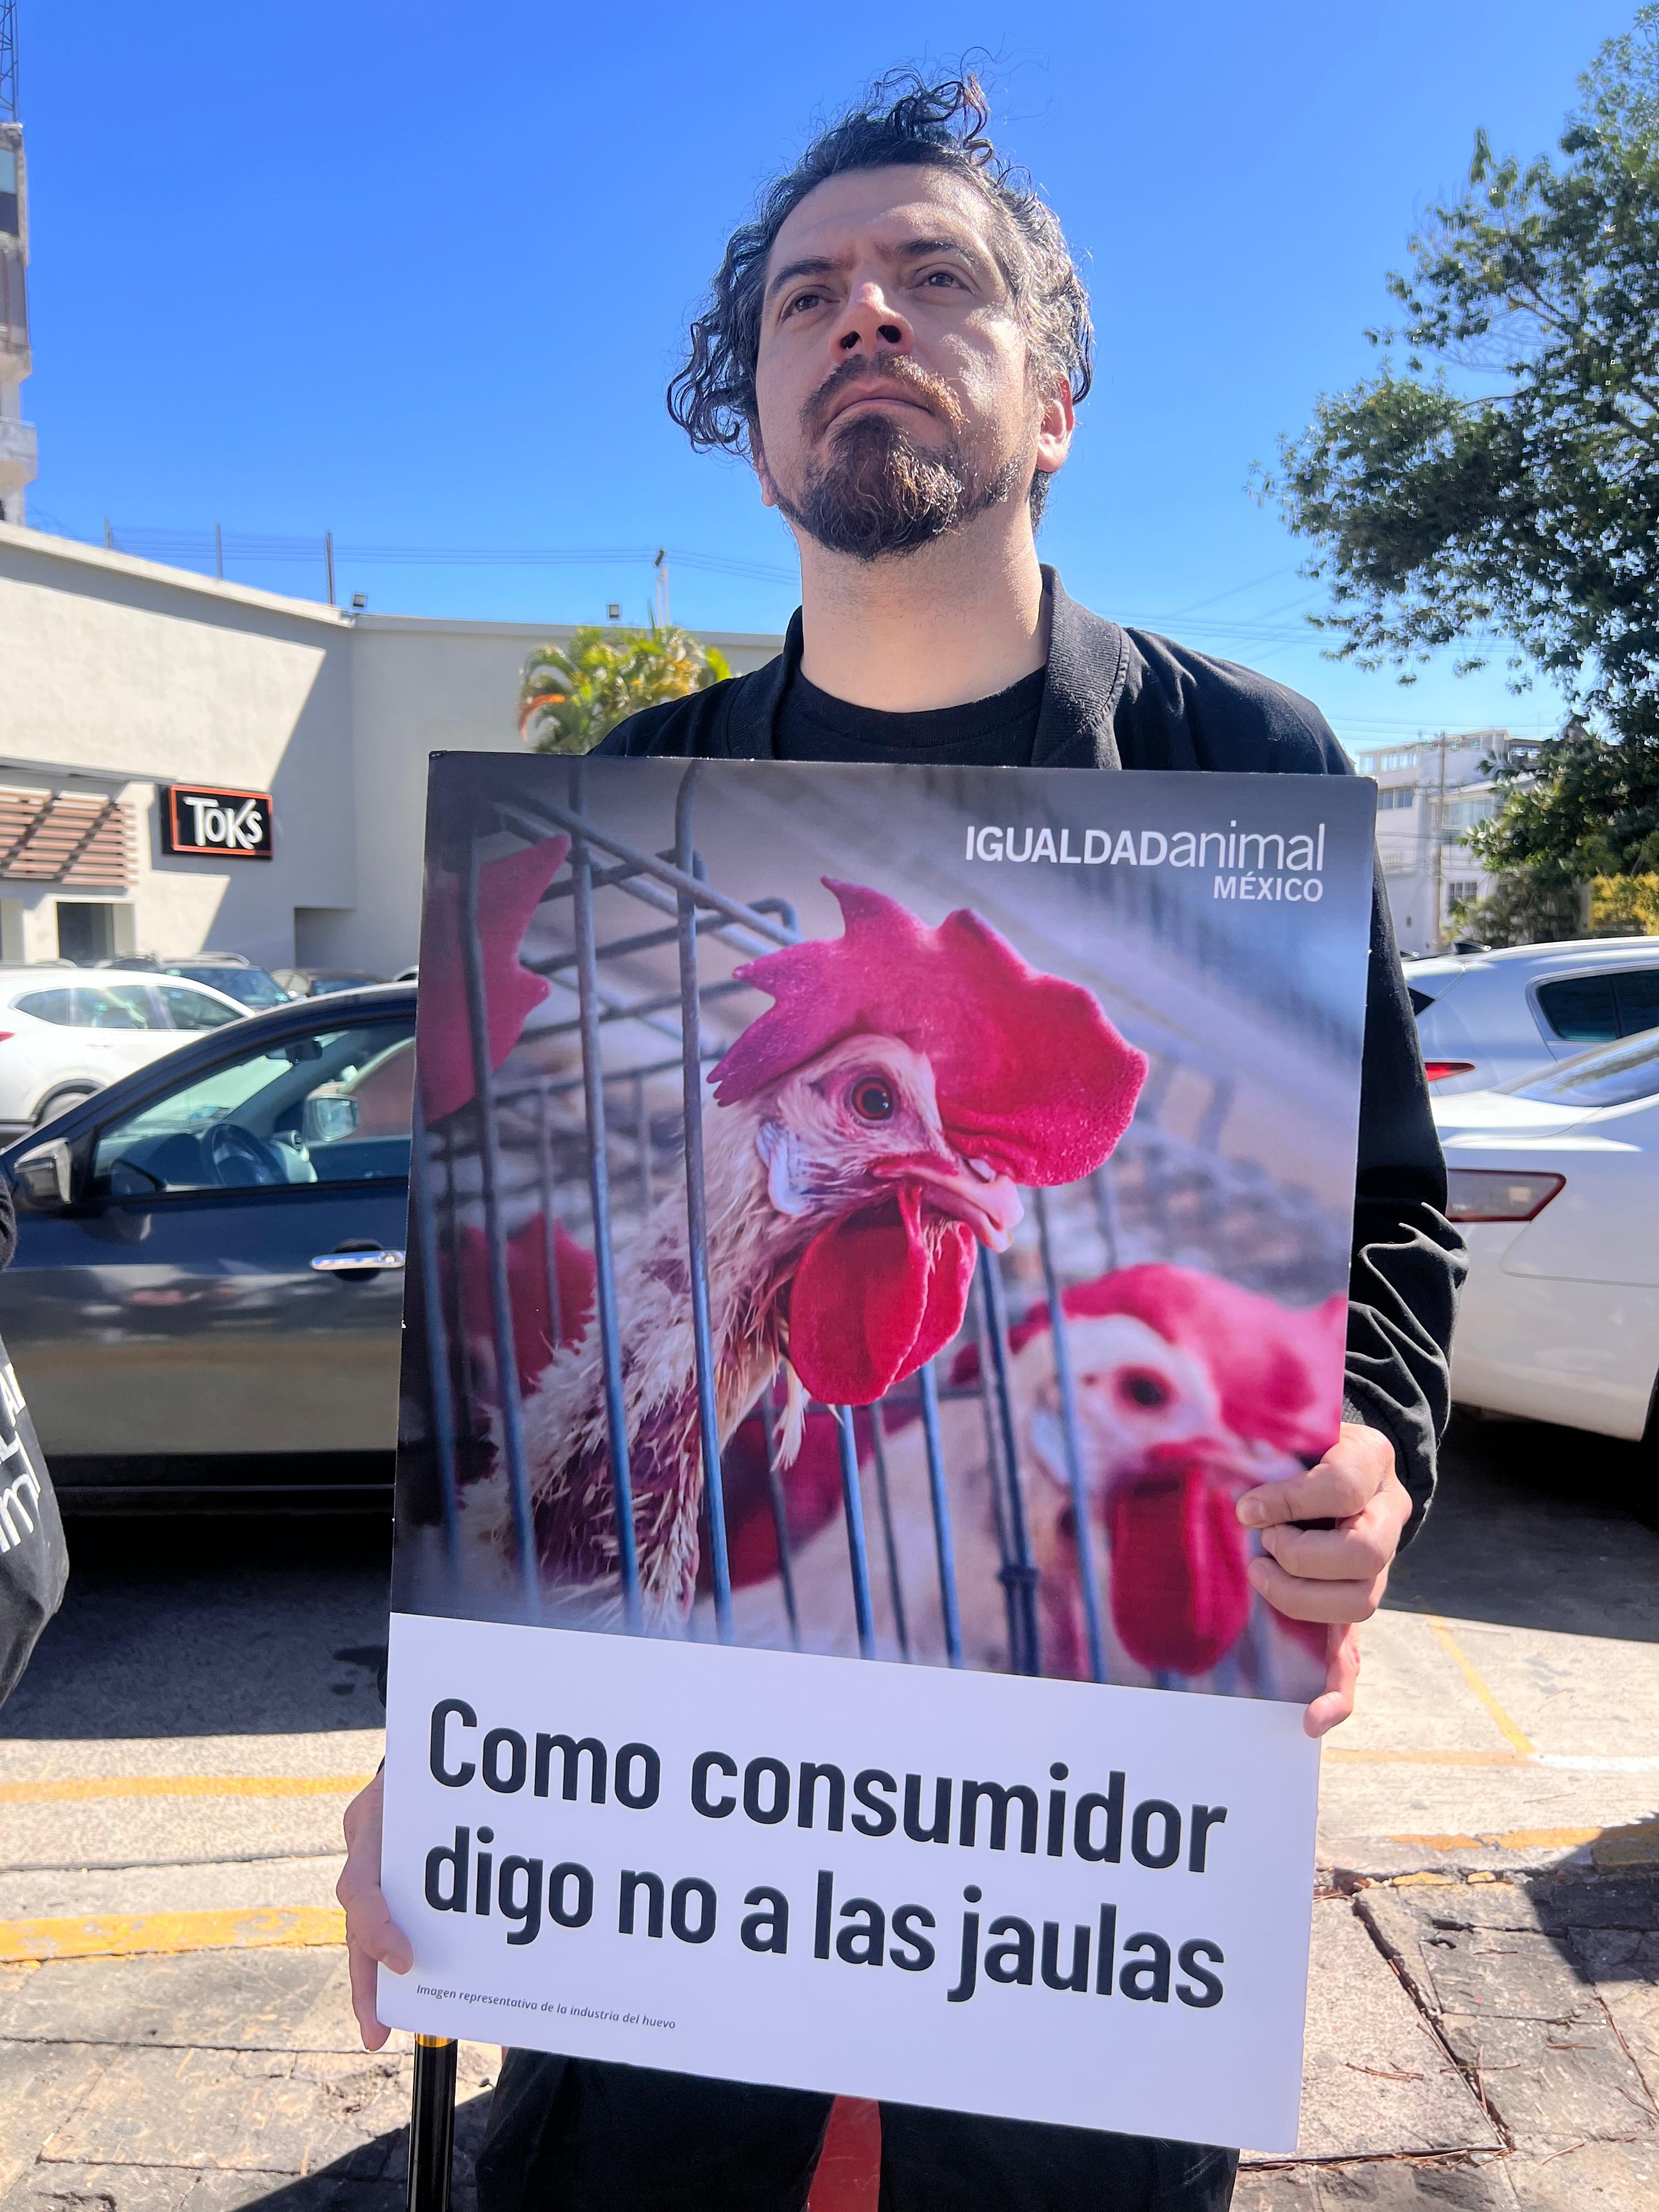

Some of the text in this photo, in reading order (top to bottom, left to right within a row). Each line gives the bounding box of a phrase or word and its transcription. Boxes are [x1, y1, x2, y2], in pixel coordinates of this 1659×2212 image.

[1214, 871, 1323, 902] MÉXICO
[430, 1699, 1228, 1873] Como consumidor
[425, 1826, 1224, 2008] digo no a las jaulas
[416, 1984, 676, 2029] Imagen representativa de la industria del huevo
